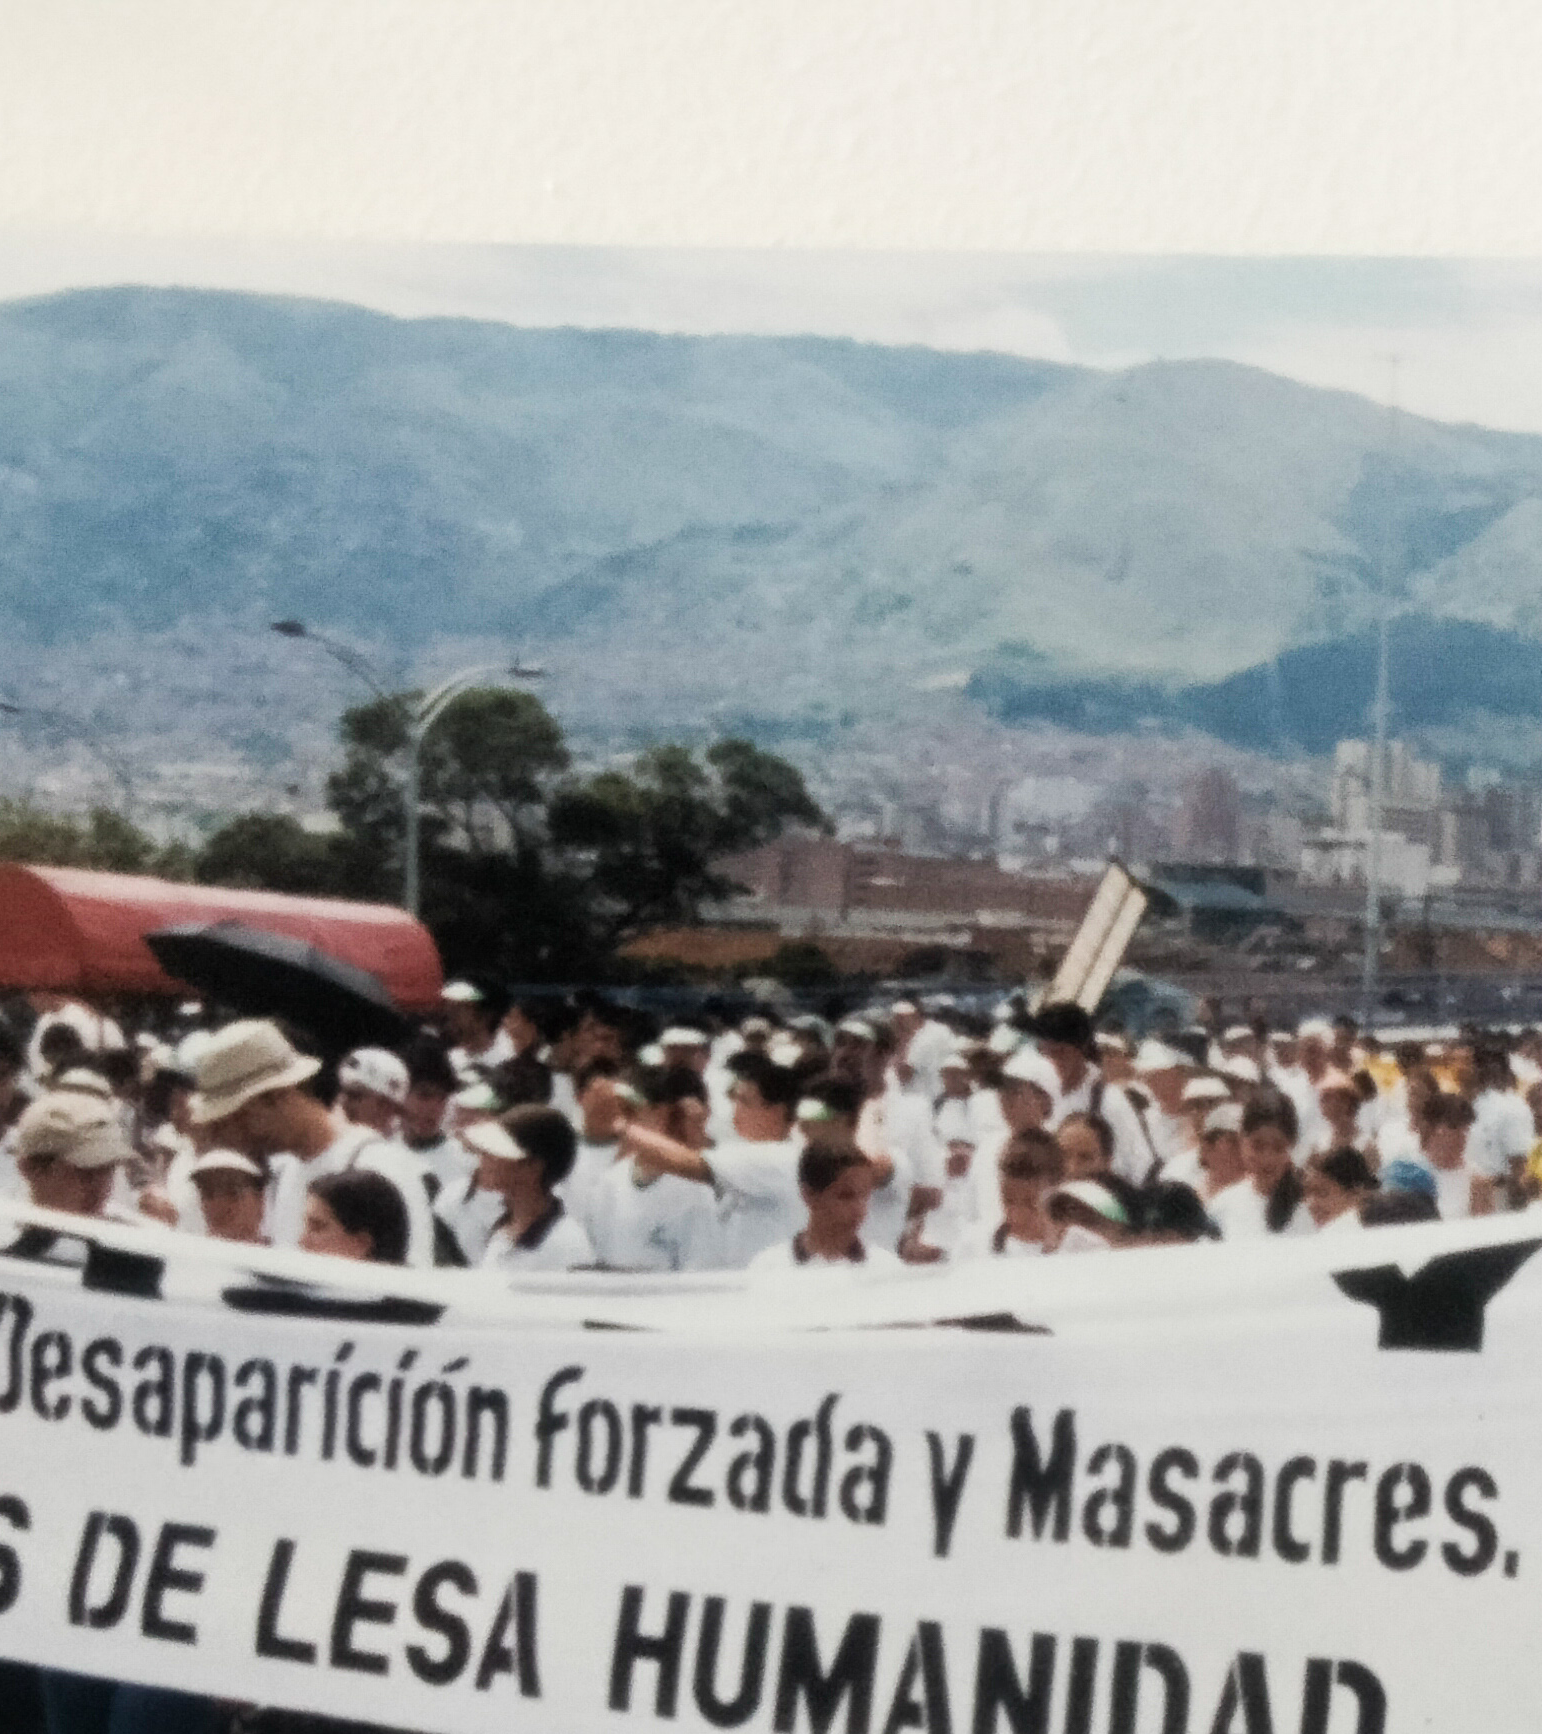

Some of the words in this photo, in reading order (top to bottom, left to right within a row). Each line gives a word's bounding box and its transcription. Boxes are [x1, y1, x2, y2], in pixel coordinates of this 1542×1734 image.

[535, 1364, 894, 1526] forzada
[924, 1430, 975, 1559] y
[1004, 1404, 1519, 1580] Masacres.
[68, 1508, 216, 1647] DE
[254, 1538, 543, 1700] LESA
